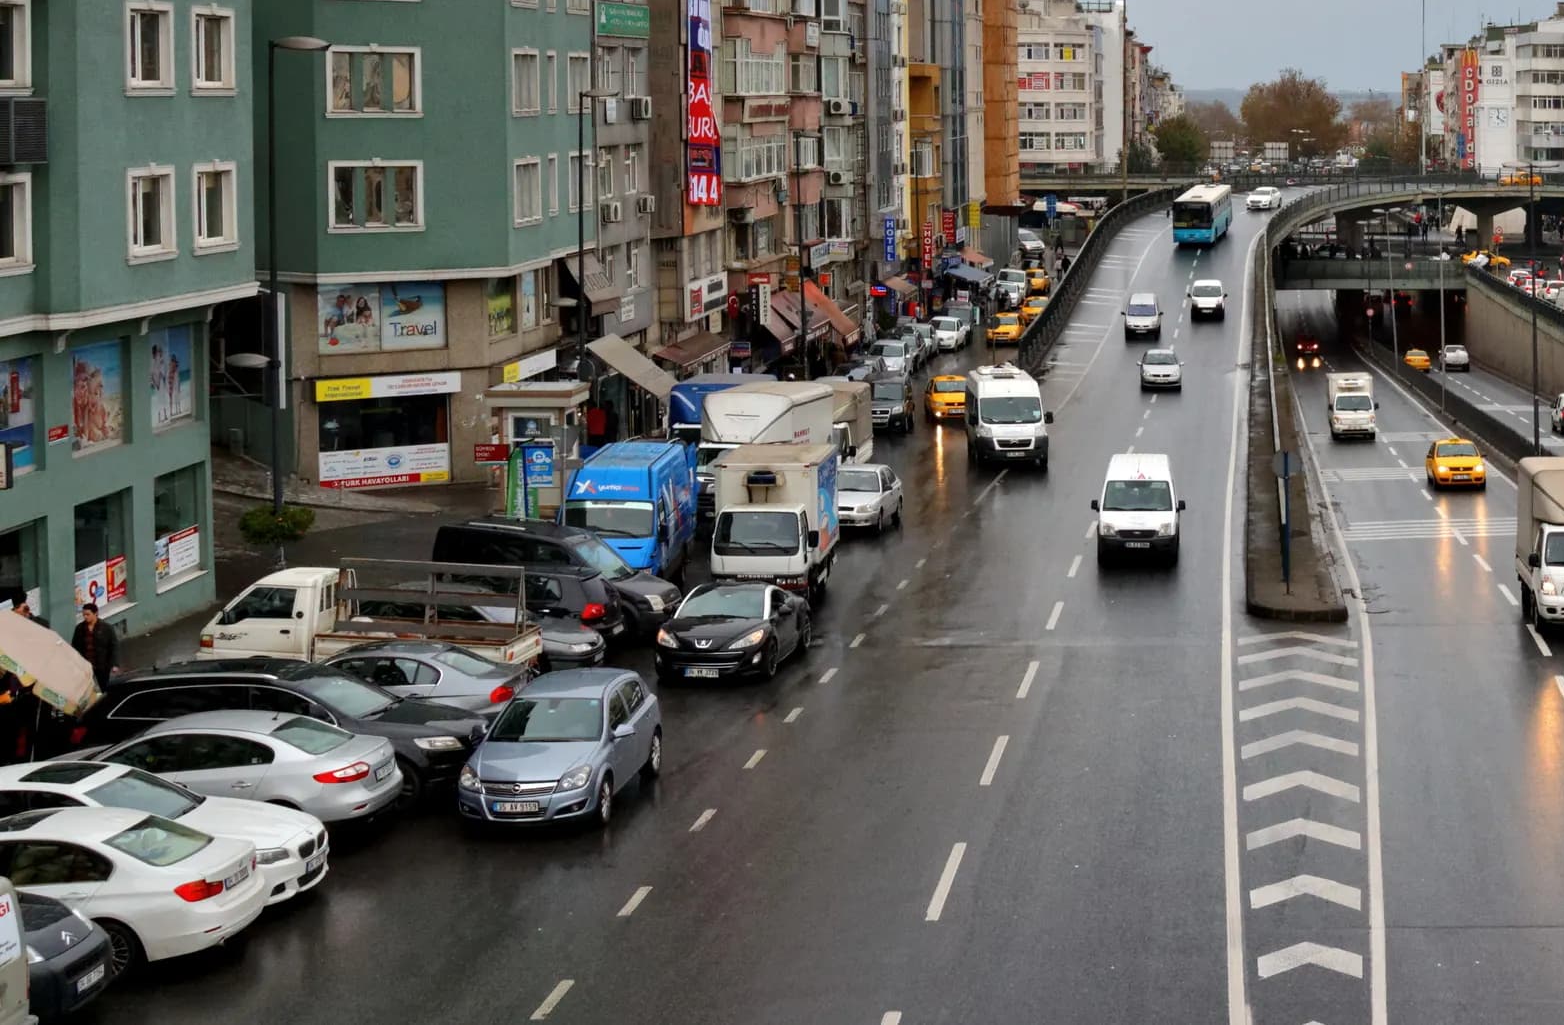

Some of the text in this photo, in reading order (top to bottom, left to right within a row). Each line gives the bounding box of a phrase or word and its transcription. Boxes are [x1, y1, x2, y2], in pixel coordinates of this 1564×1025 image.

[886, 220, 894, 261] HOTEL
[389, 320, 437, 337] Travel
[361, 475, 409, 485] HAVAYOLLARI
